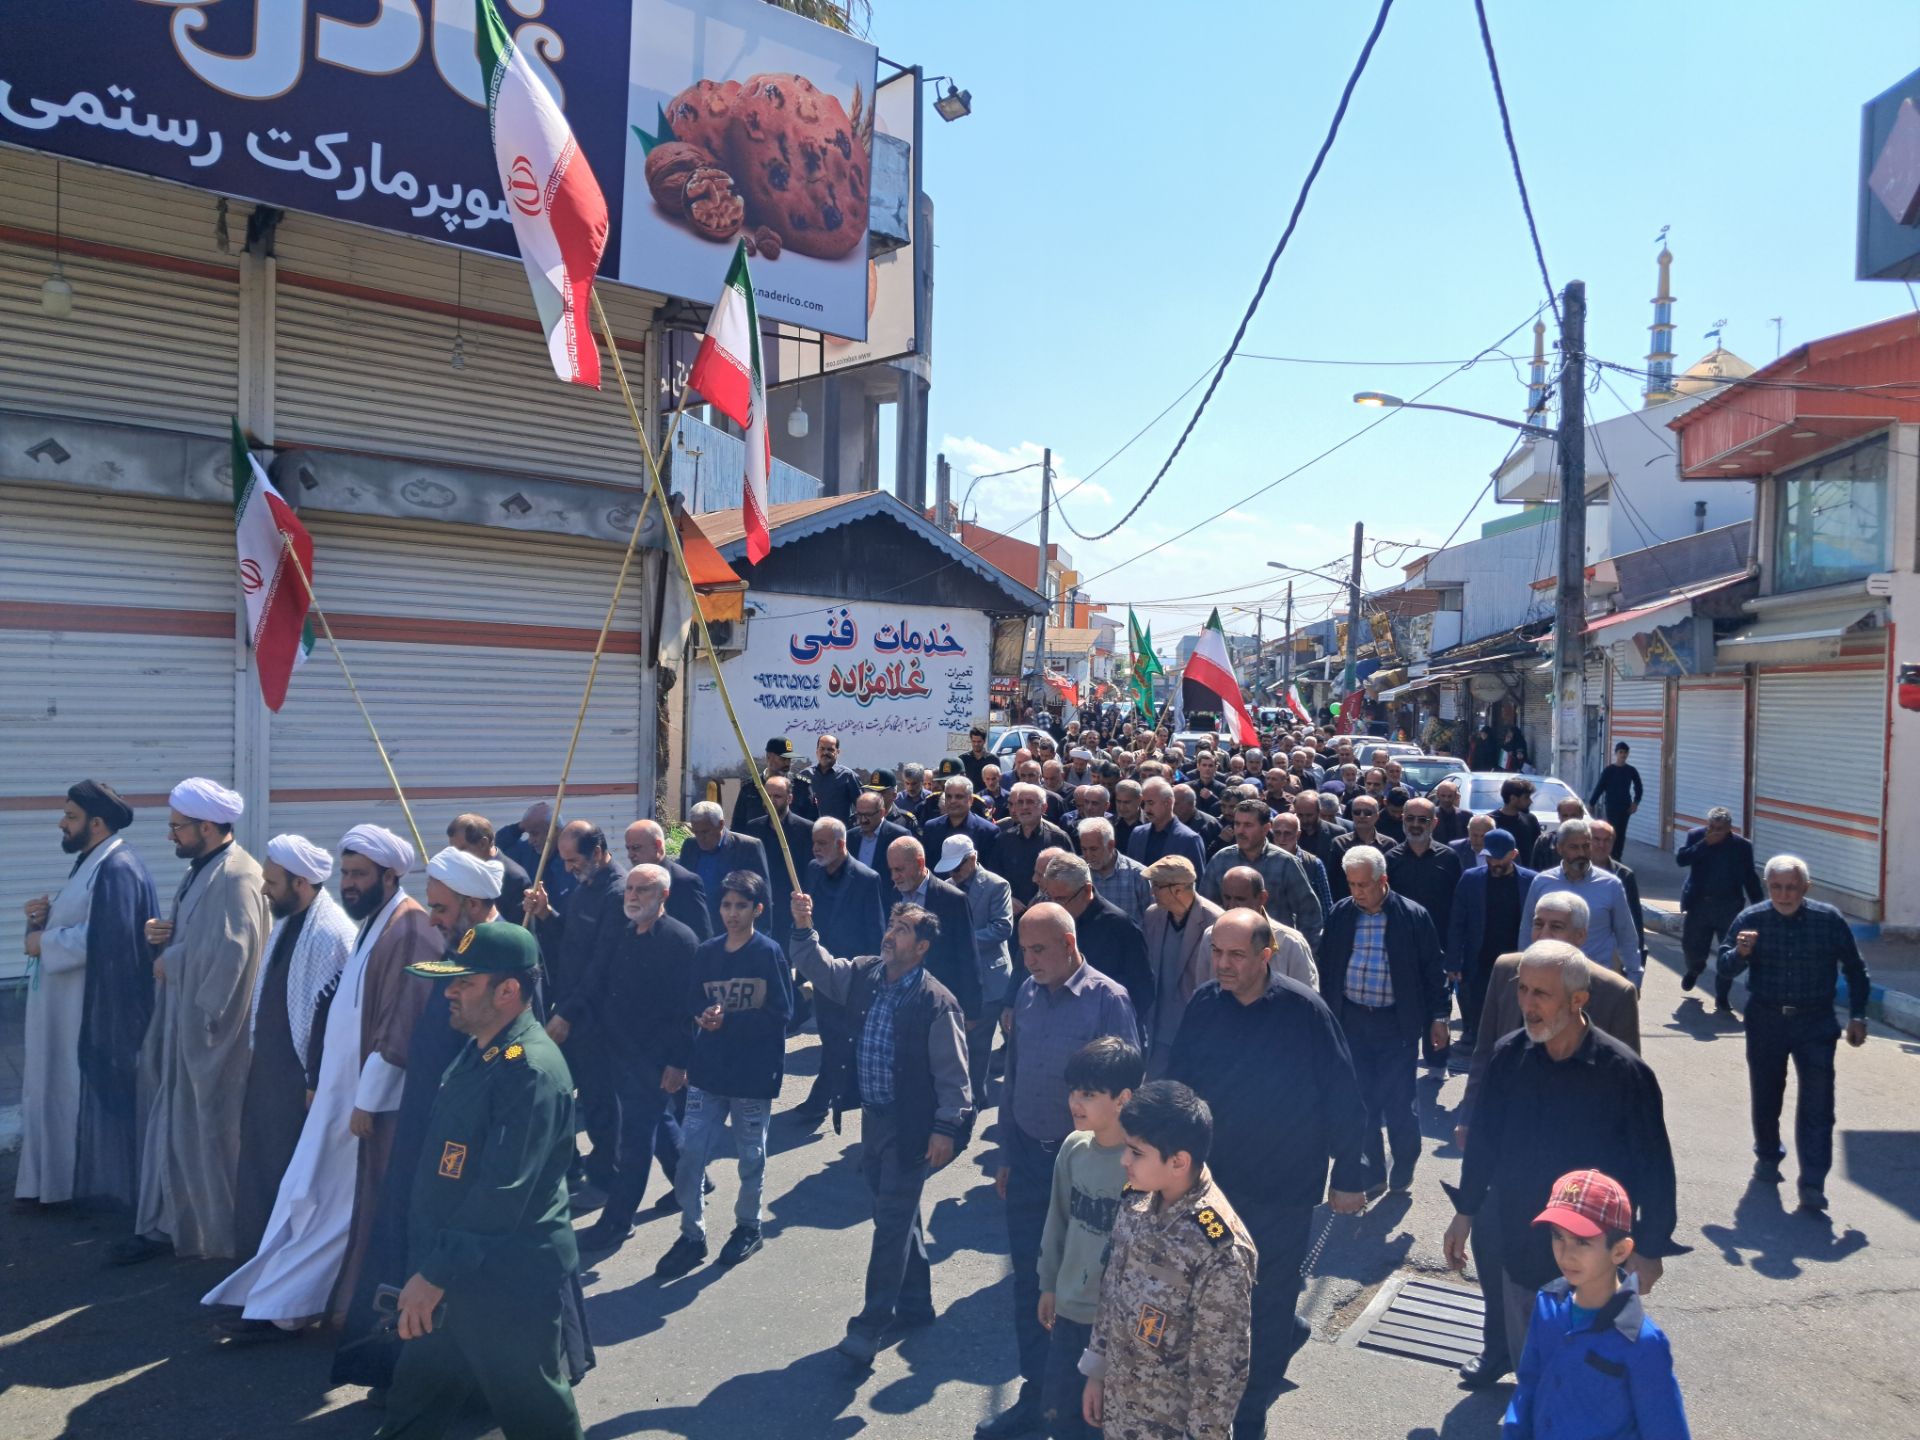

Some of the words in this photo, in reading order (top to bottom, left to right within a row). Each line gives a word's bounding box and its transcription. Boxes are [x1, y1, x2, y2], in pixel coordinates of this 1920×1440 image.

[0, 79, 223, 167] رستمی
[752, 287, 824, 312] .naderico.com
[874, 619, 967, 657] خدمات
[828, 657, 932, 707] غلامزاده
